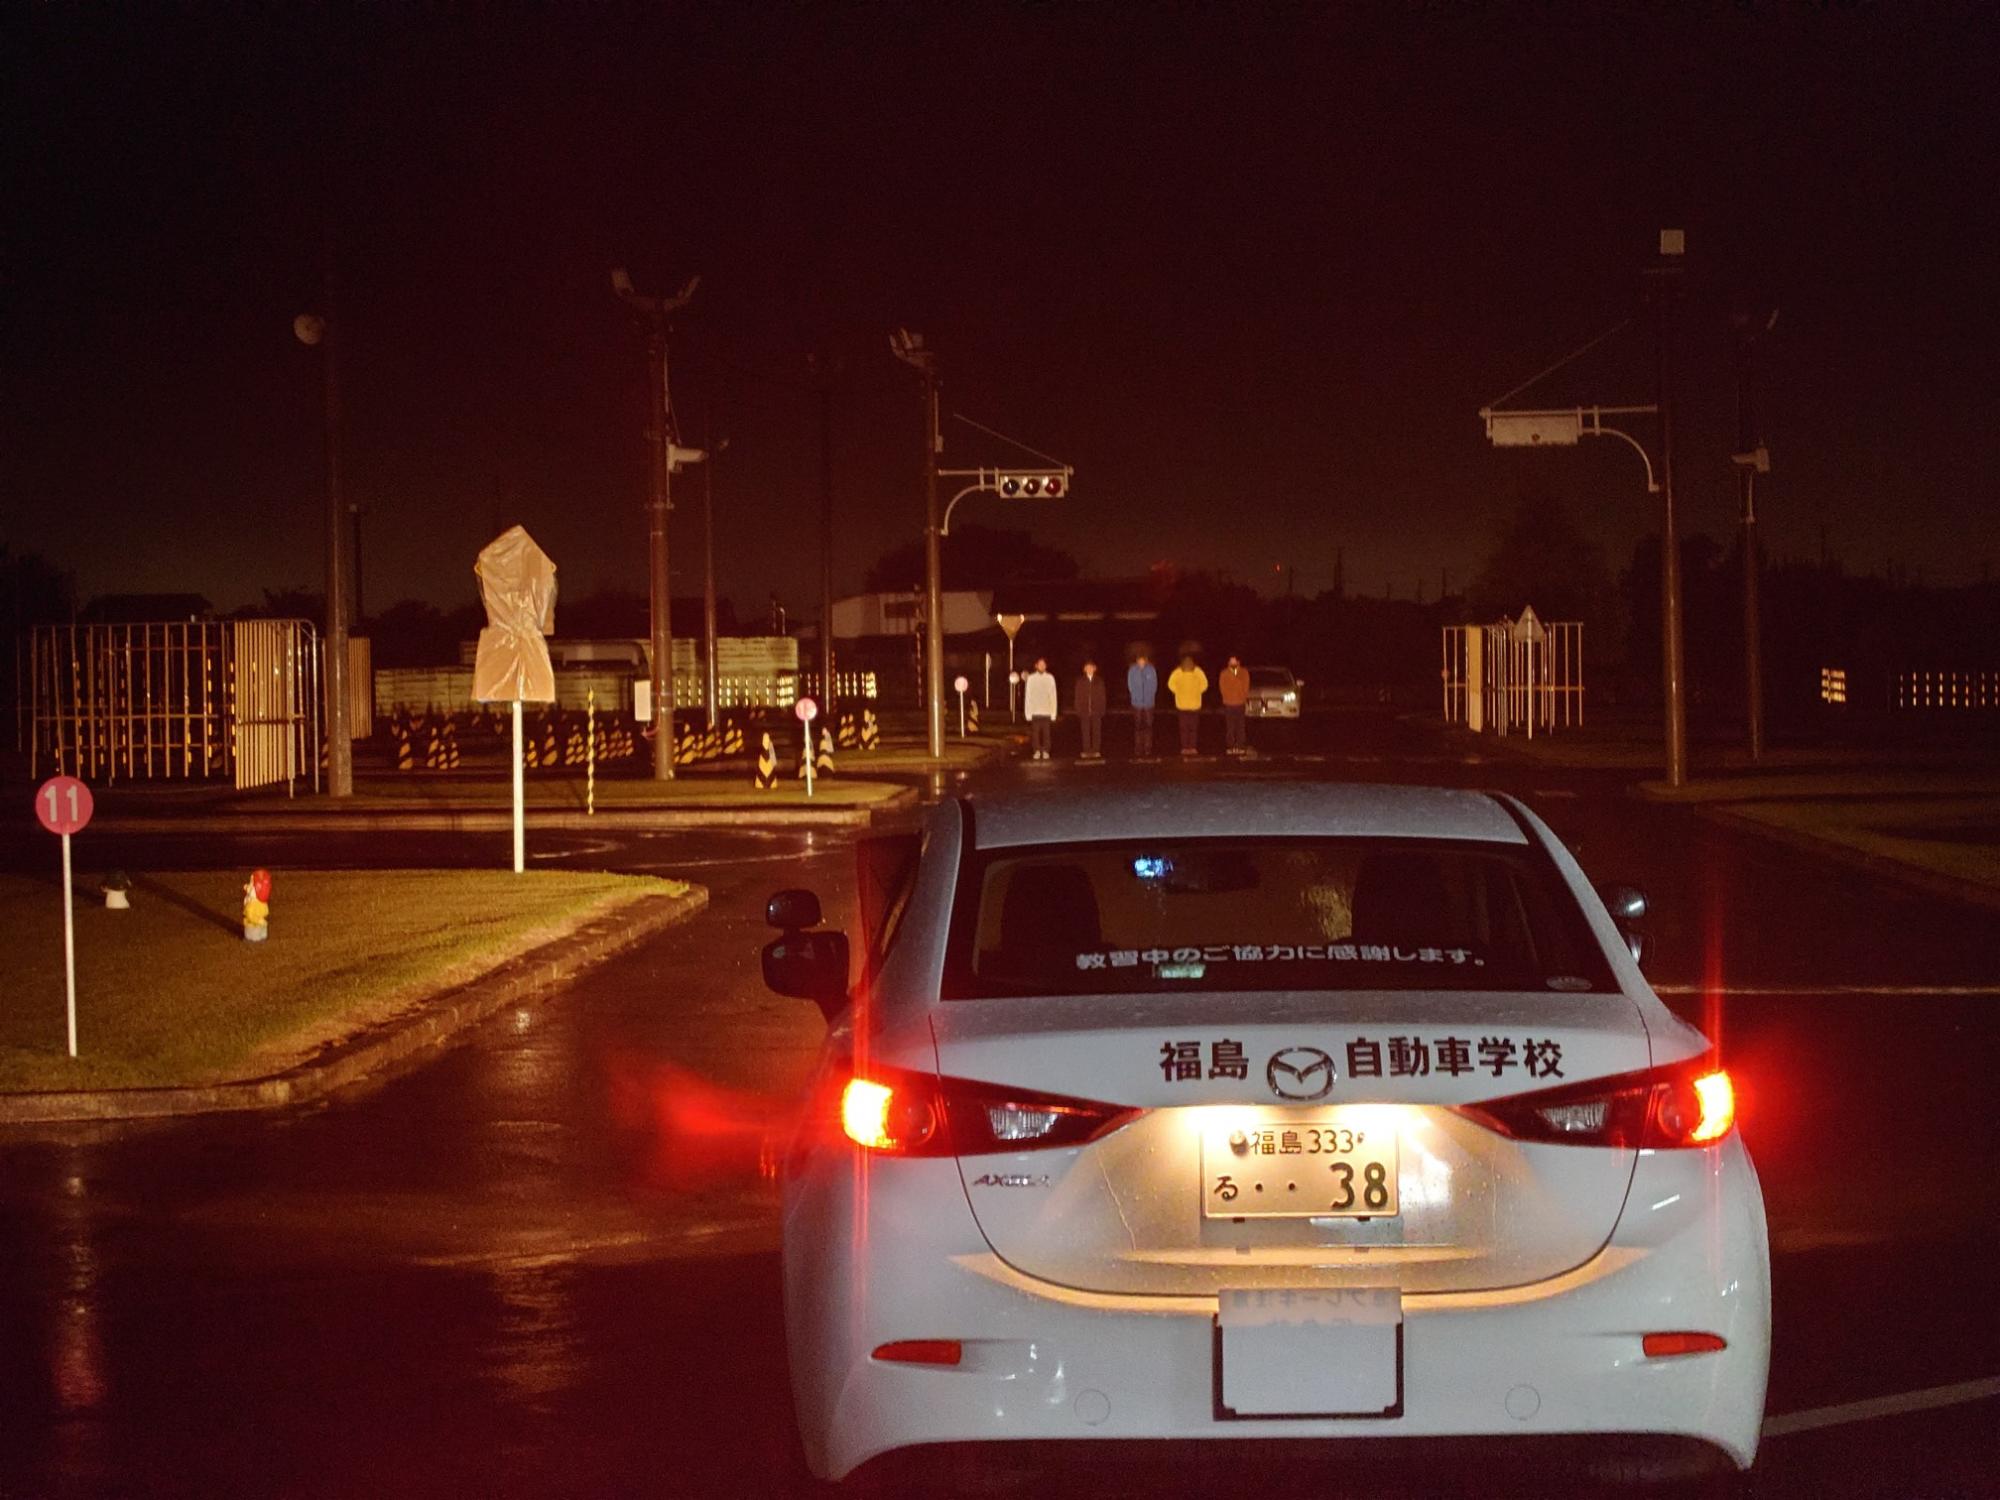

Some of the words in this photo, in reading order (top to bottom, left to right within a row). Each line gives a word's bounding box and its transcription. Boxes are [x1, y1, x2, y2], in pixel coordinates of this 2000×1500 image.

[44, 784, 79, 823] 11
[1159, 1038, 1249, 1082] 福島
[1345, 1036, 1566, 1079] 自動車学校
[1250, 1129, 1303, 1156] 福島
[1307, 1129, 1355, 1155] 333
[1213, 1175, 1240, 1202] る
[1329, 1161, 1389, 1209] 38
